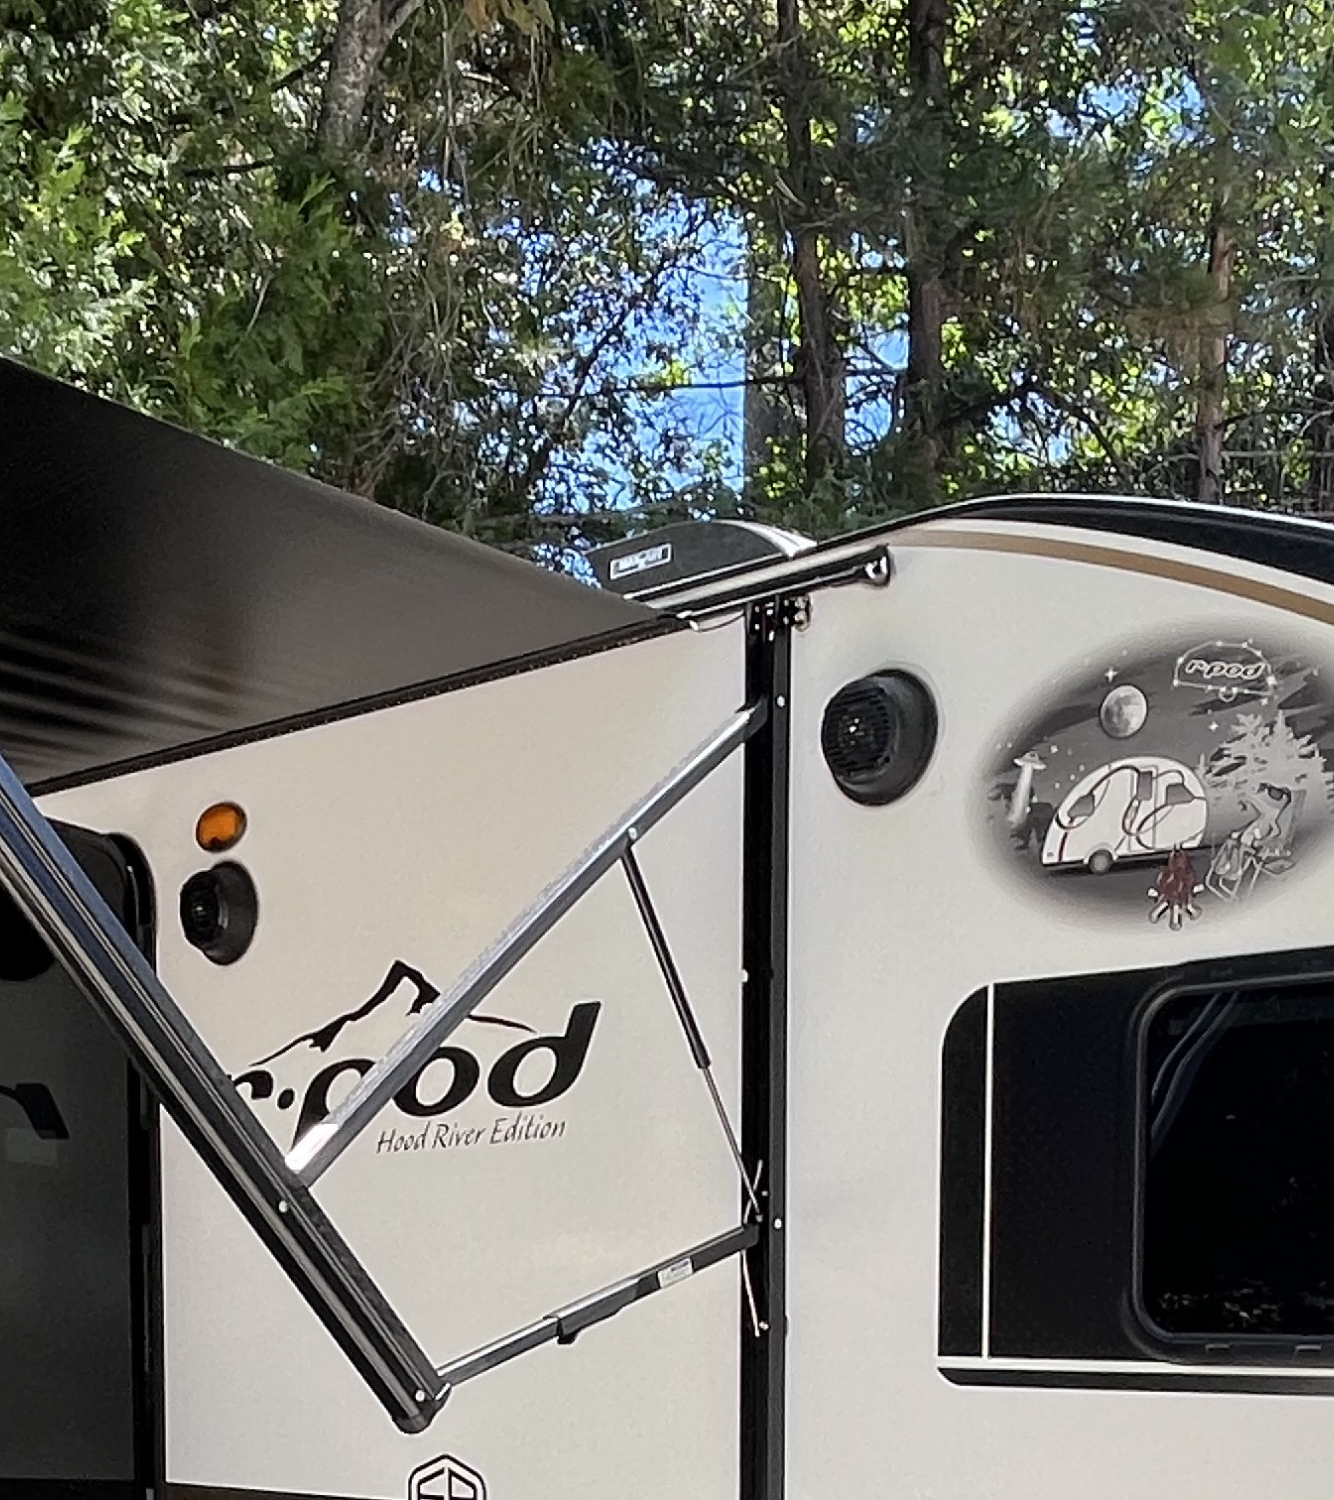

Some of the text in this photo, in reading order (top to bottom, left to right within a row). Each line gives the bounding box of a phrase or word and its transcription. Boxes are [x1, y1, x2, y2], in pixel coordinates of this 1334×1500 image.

[376, 1110, 566, 1154] Hood River Edition
